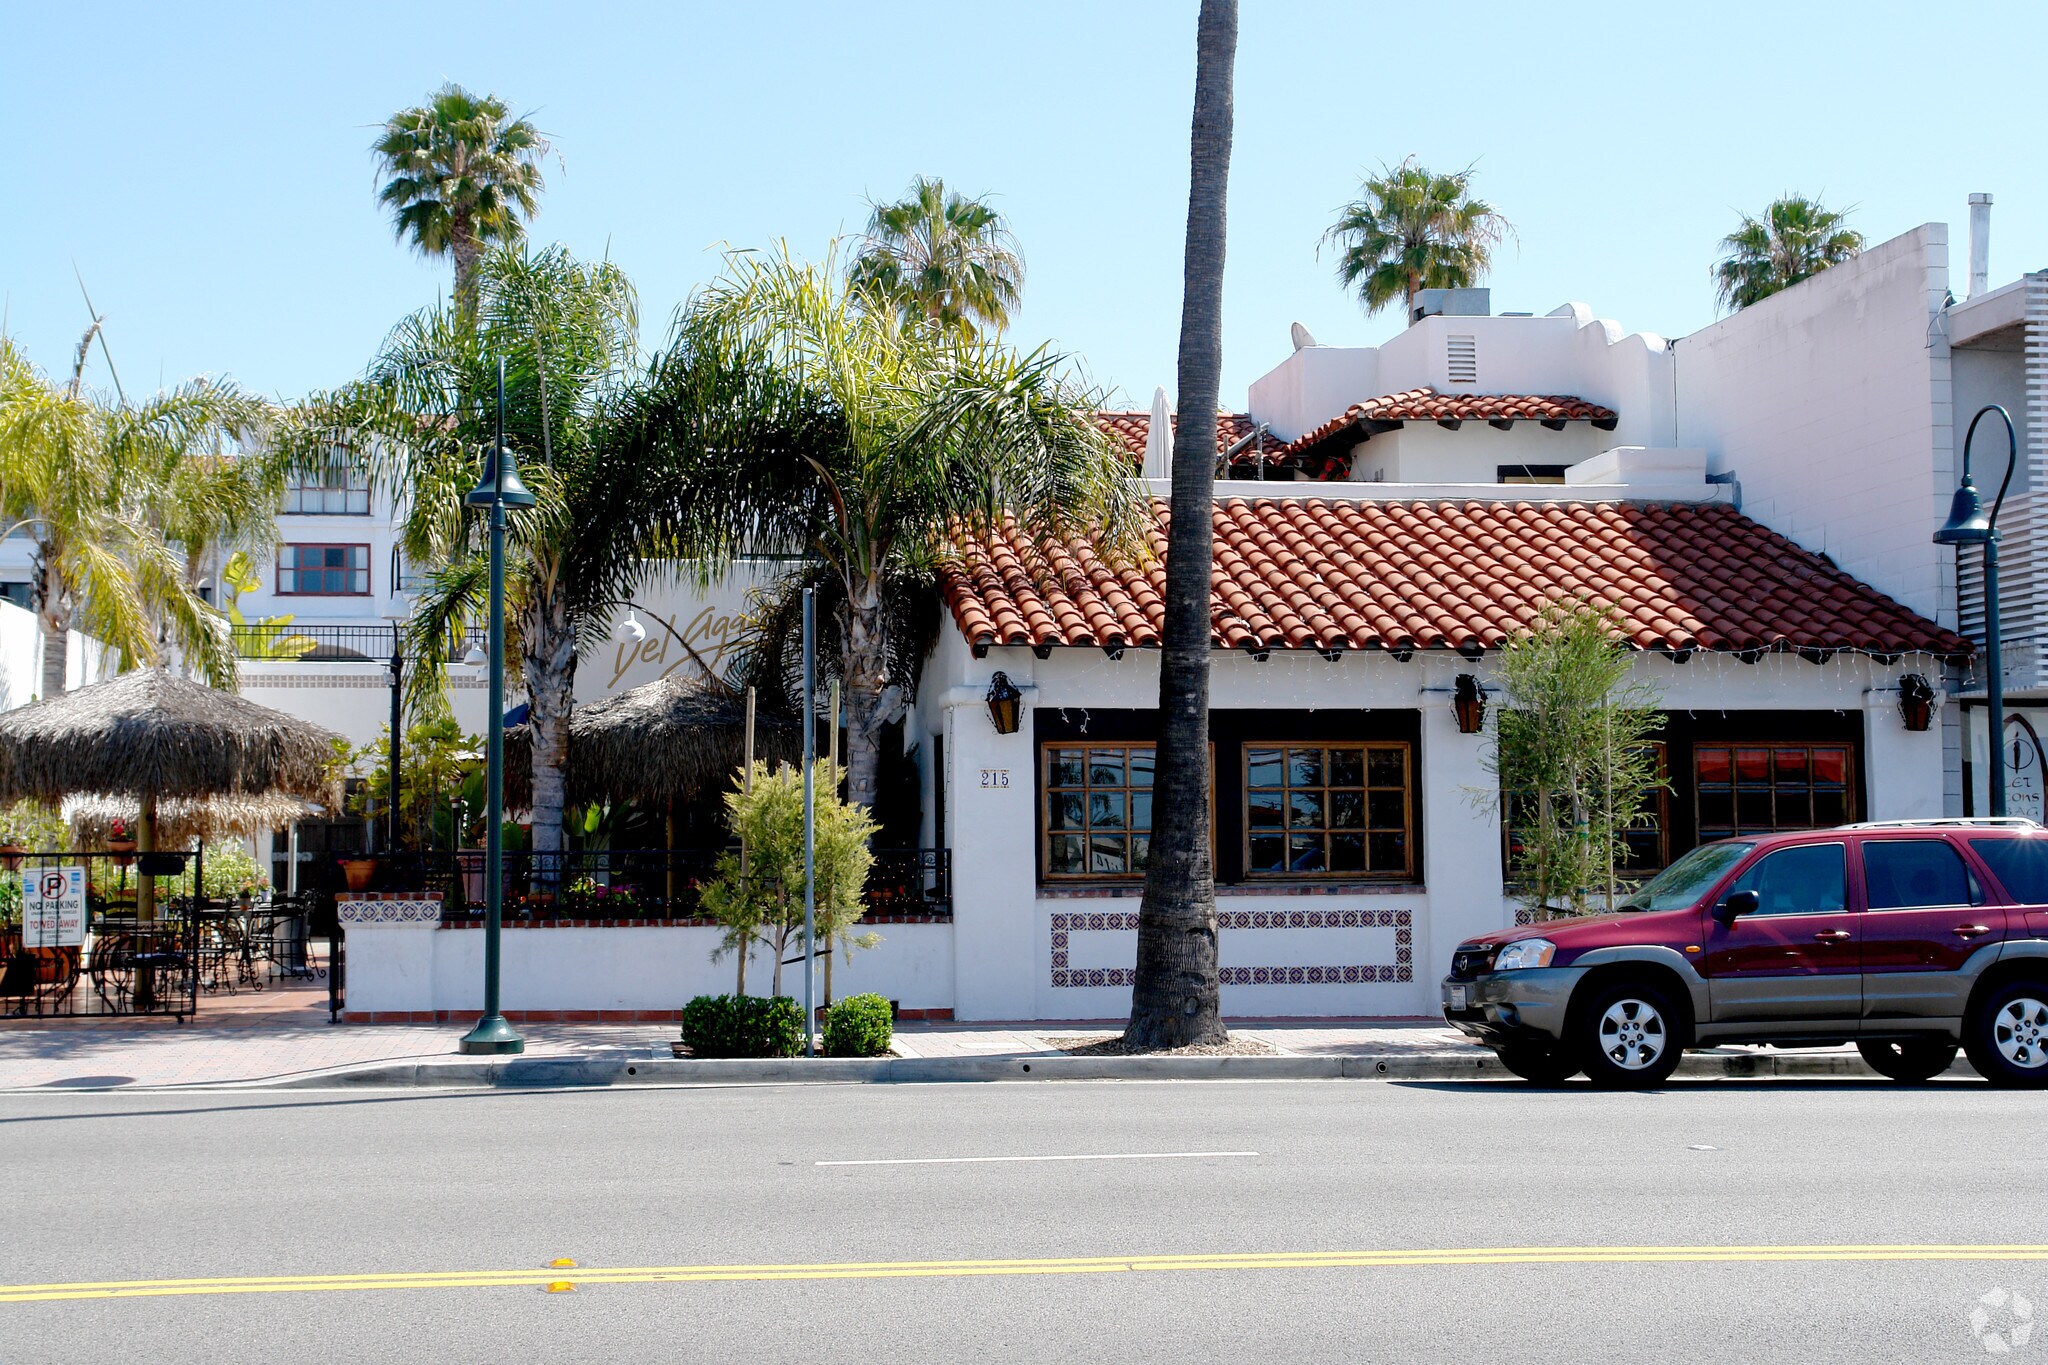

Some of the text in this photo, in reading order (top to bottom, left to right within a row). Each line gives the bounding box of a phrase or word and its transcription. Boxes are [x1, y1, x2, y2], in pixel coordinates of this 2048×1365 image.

[981, 771, 1009, 786] 215
[29, 901, 42, 911] NO
[58, 919, 79, 928] AWAY
